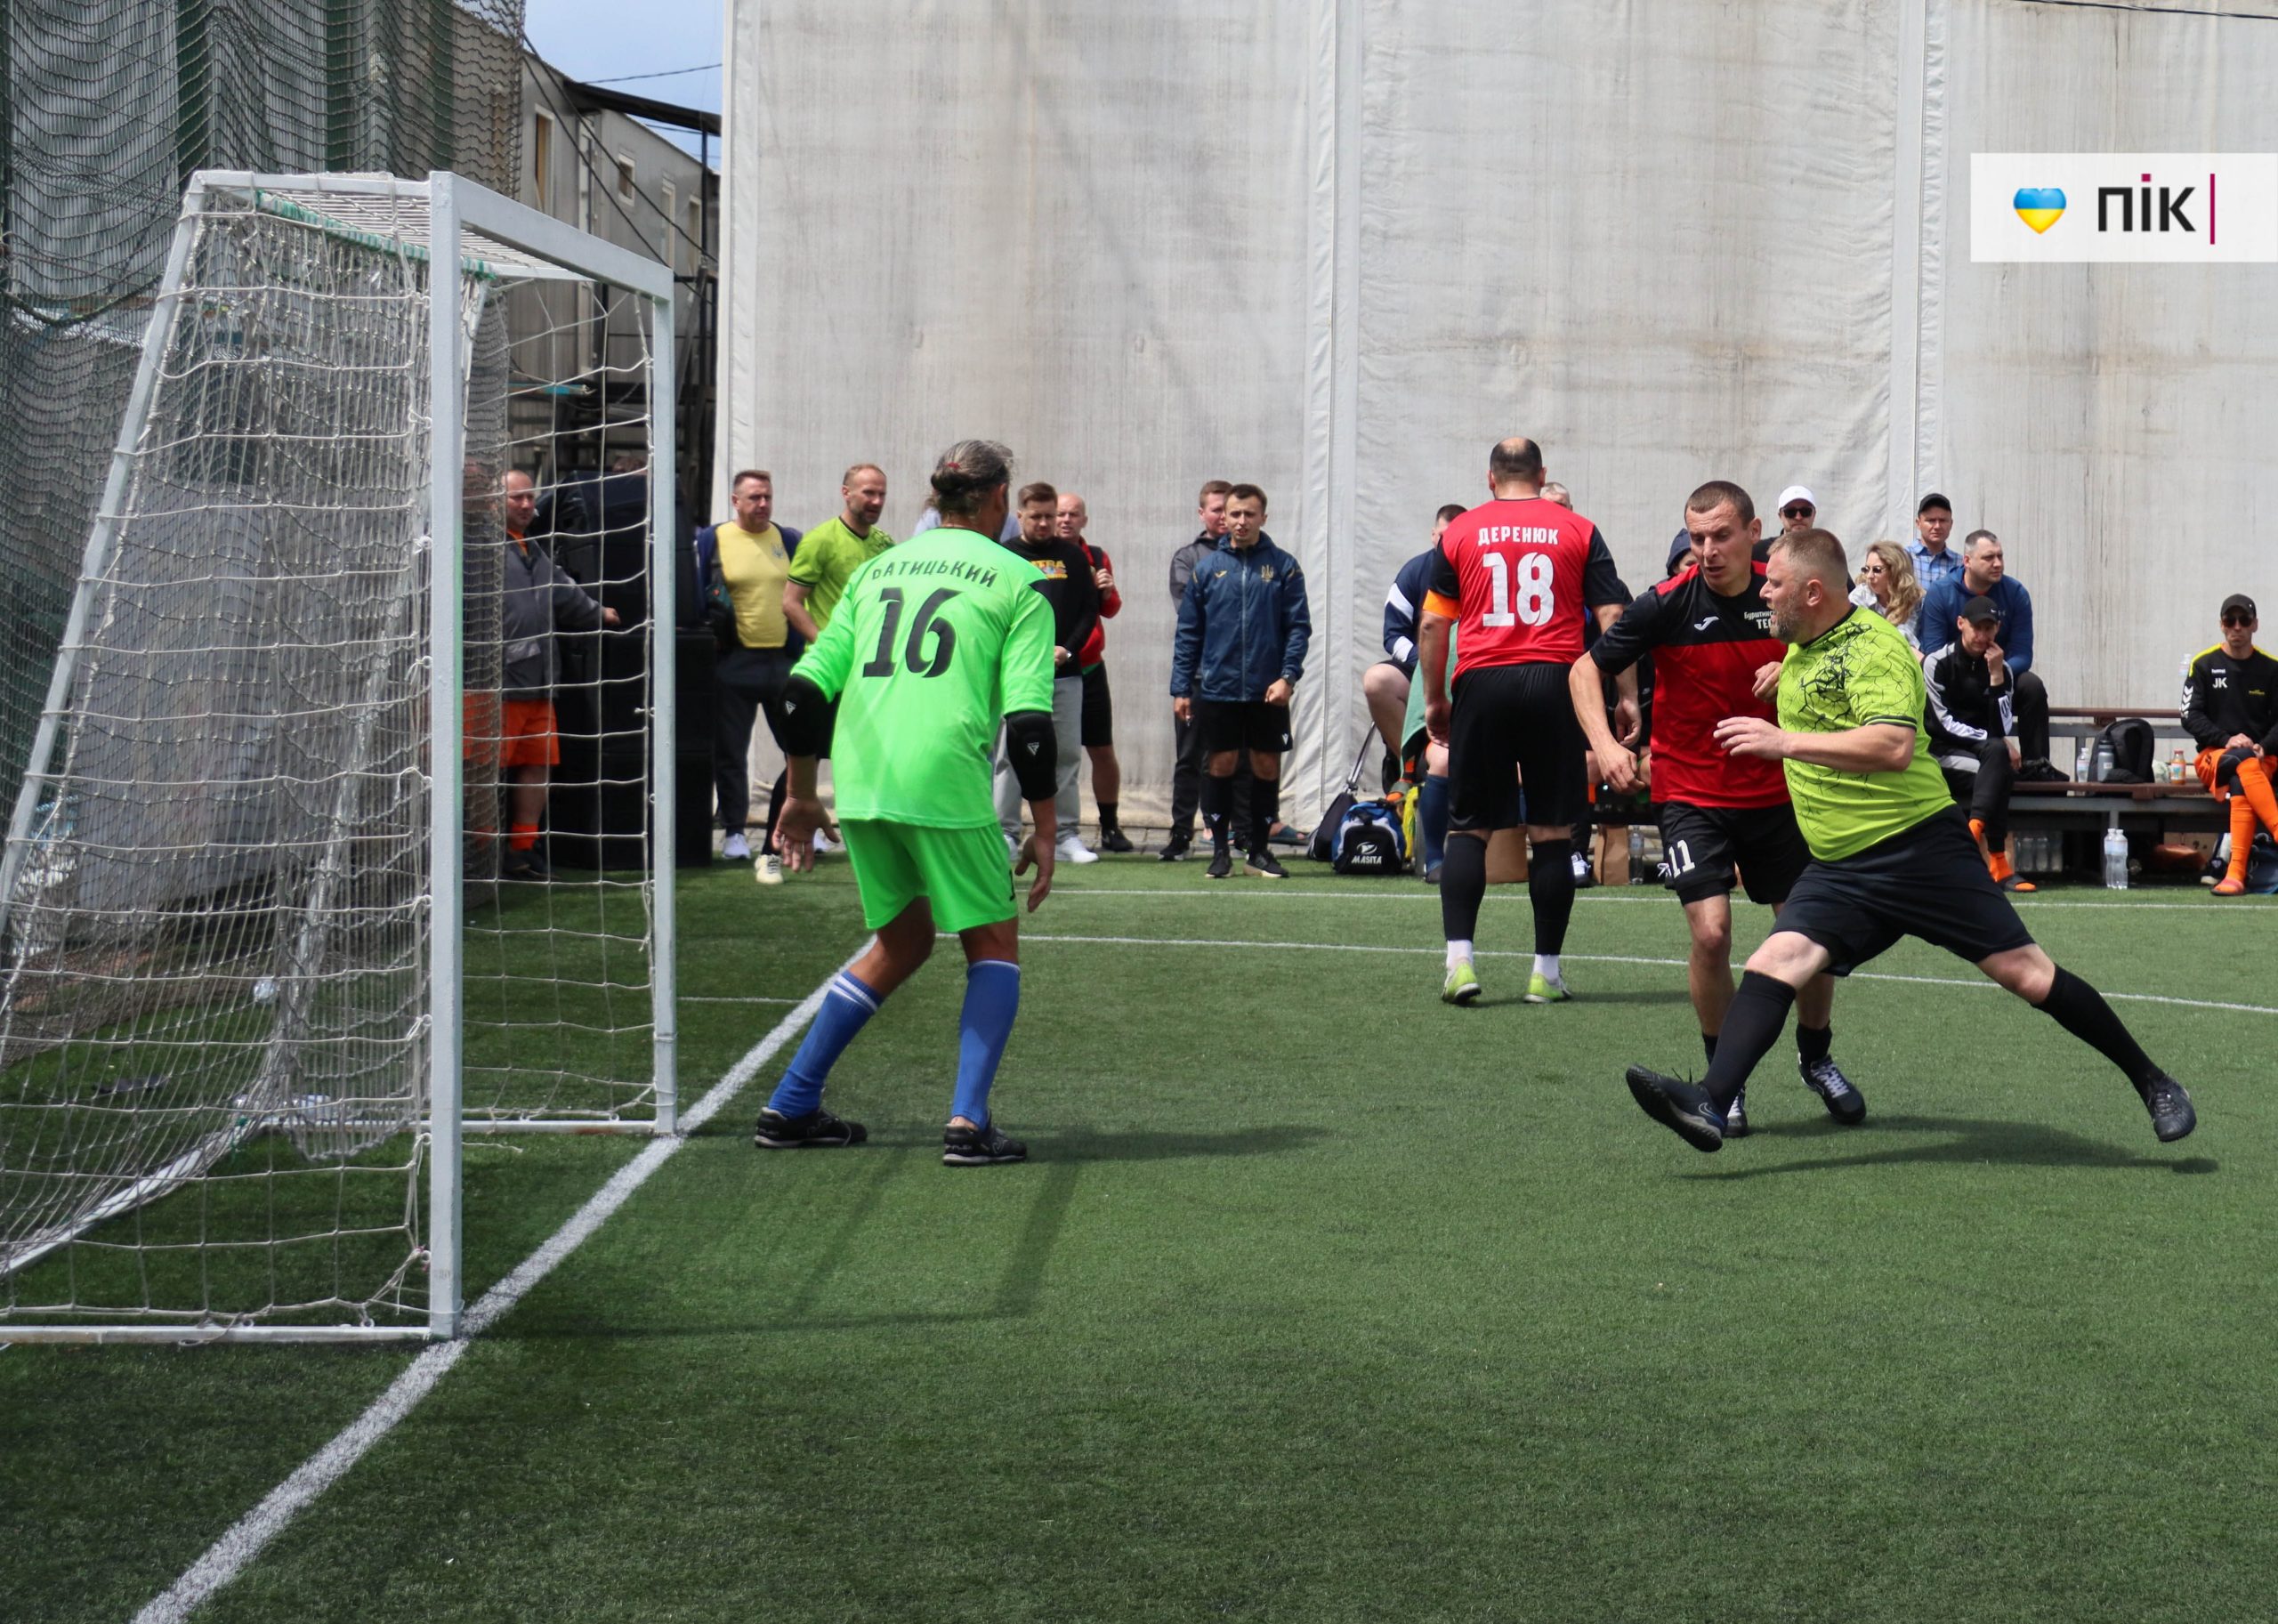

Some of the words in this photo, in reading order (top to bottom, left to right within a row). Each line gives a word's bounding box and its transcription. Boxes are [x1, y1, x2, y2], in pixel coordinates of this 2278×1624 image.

[1478, 526, 1559, 546] ДЕРЕНЮК
[1482, 552, 1555, 627] 18
[862, 587, 965, 678] 16
[2212, 676, 2227, 689] JK
[1351, 855, 1382, 865] MASITA
[1668, 839, 1695, 879] 11
